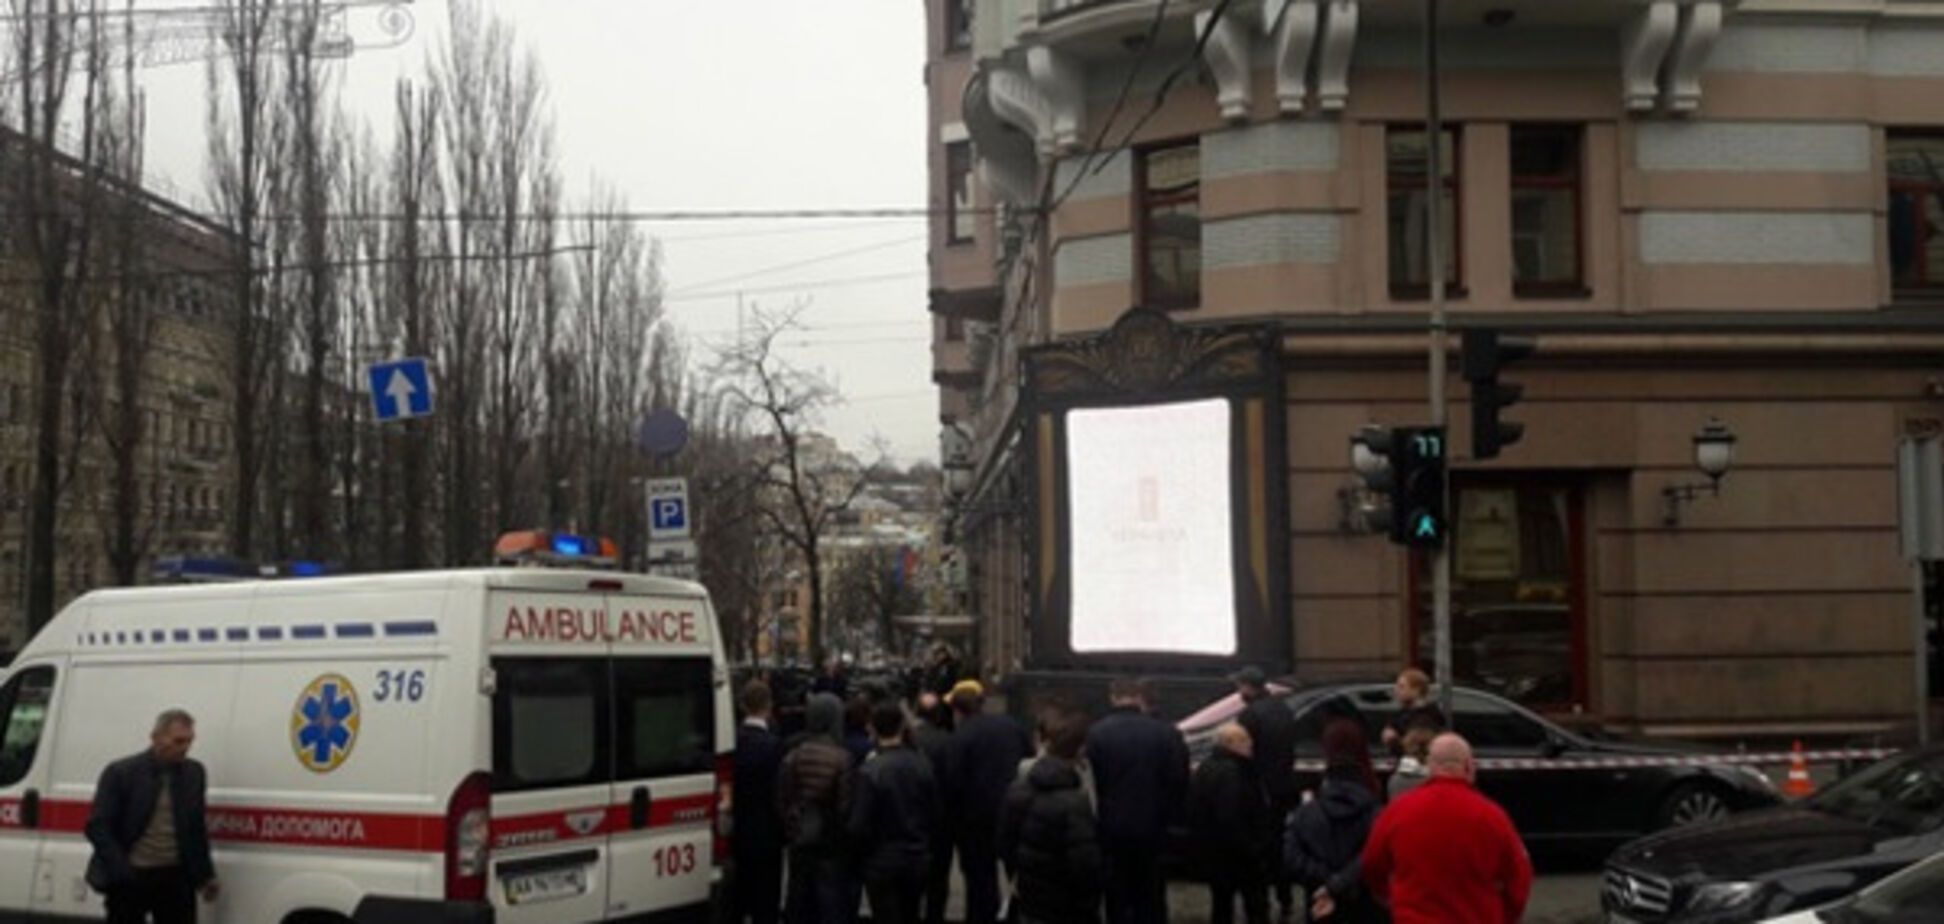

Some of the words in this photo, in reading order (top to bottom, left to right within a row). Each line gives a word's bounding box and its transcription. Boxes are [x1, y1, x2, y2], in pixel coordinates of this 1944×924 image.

[660, 501, 679, 526] P
[504, 605, 696, 642] AMBULANCE
[373, 670, 425, 702] 316
[261, 814, 365, 840] ДОПОМОГА
[652, 842, 696, 878] 103
